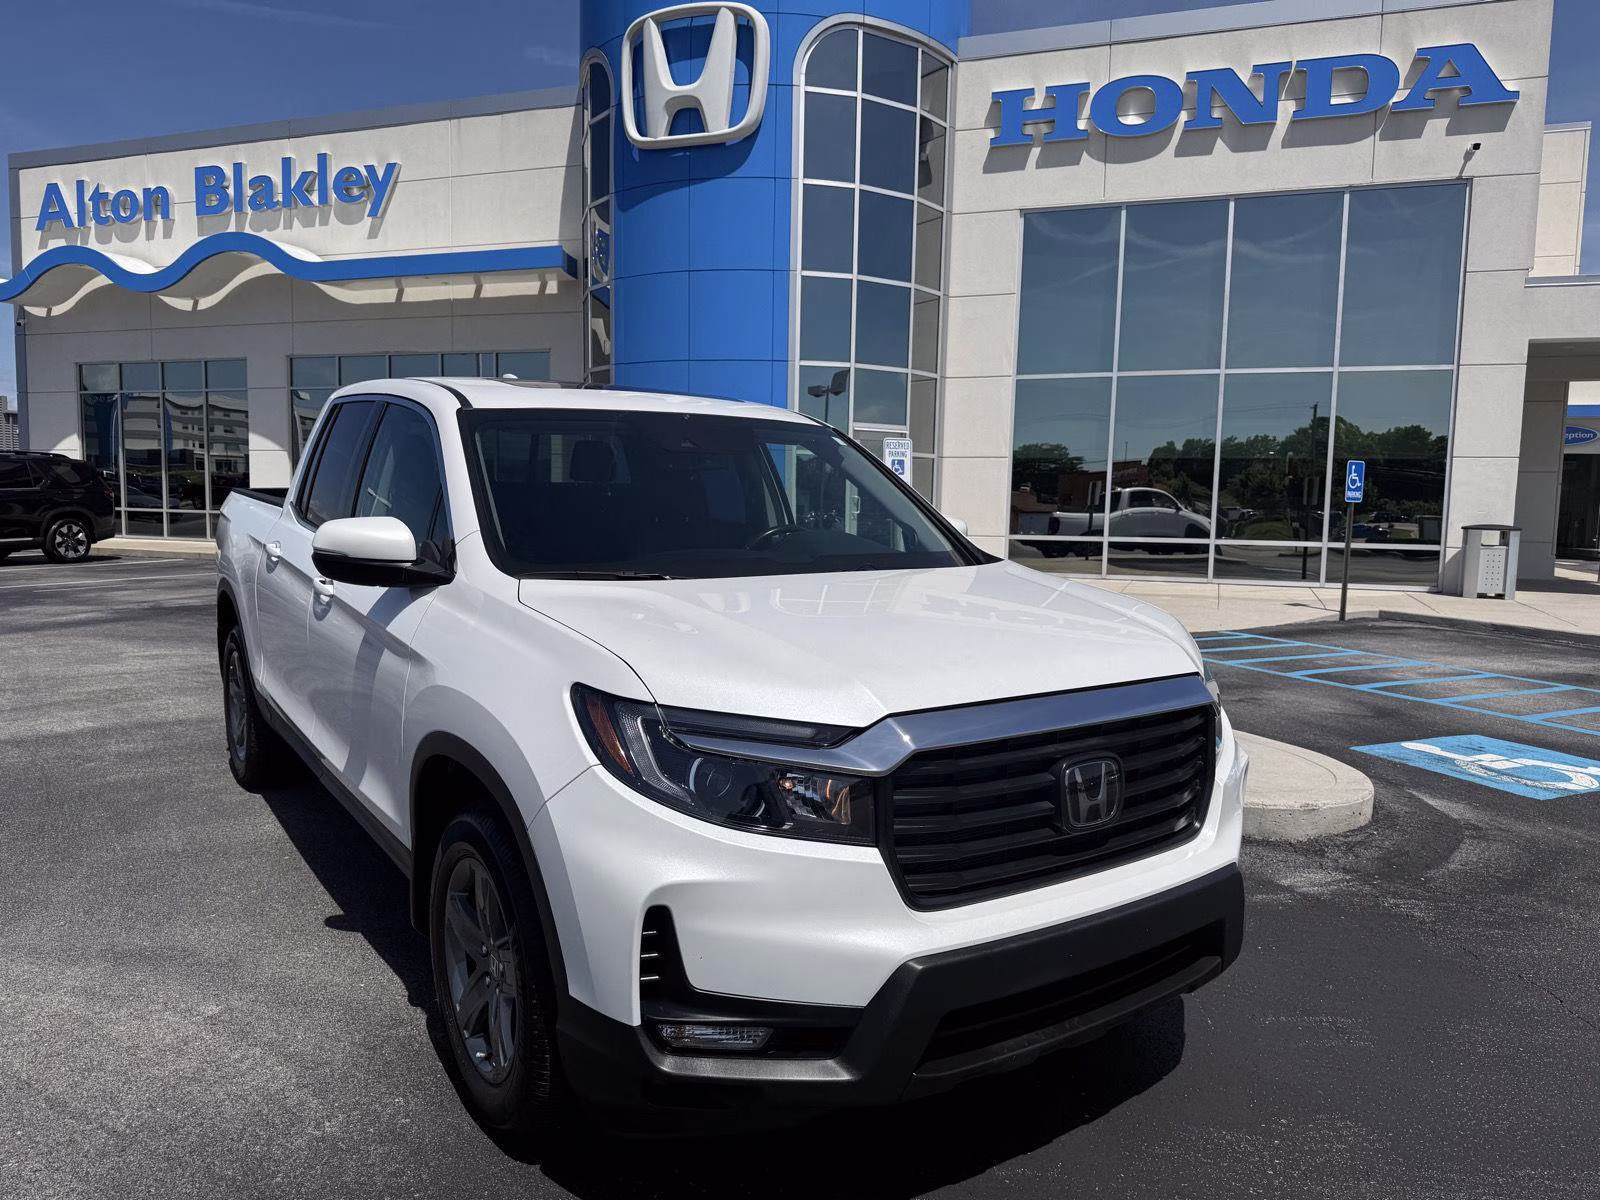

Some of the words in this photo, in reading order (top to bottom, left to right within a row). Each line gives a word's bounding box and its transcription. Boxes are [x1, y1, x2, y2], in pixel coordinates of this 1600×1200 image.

[990, 42, 1520, 147] HONDA
[35, 179, 174, 232] Alton
[194, 152, 401, 219] Blakley
[886, 441, 909, 449] RESERVED
[889, 450, 907, 458] PARKING
